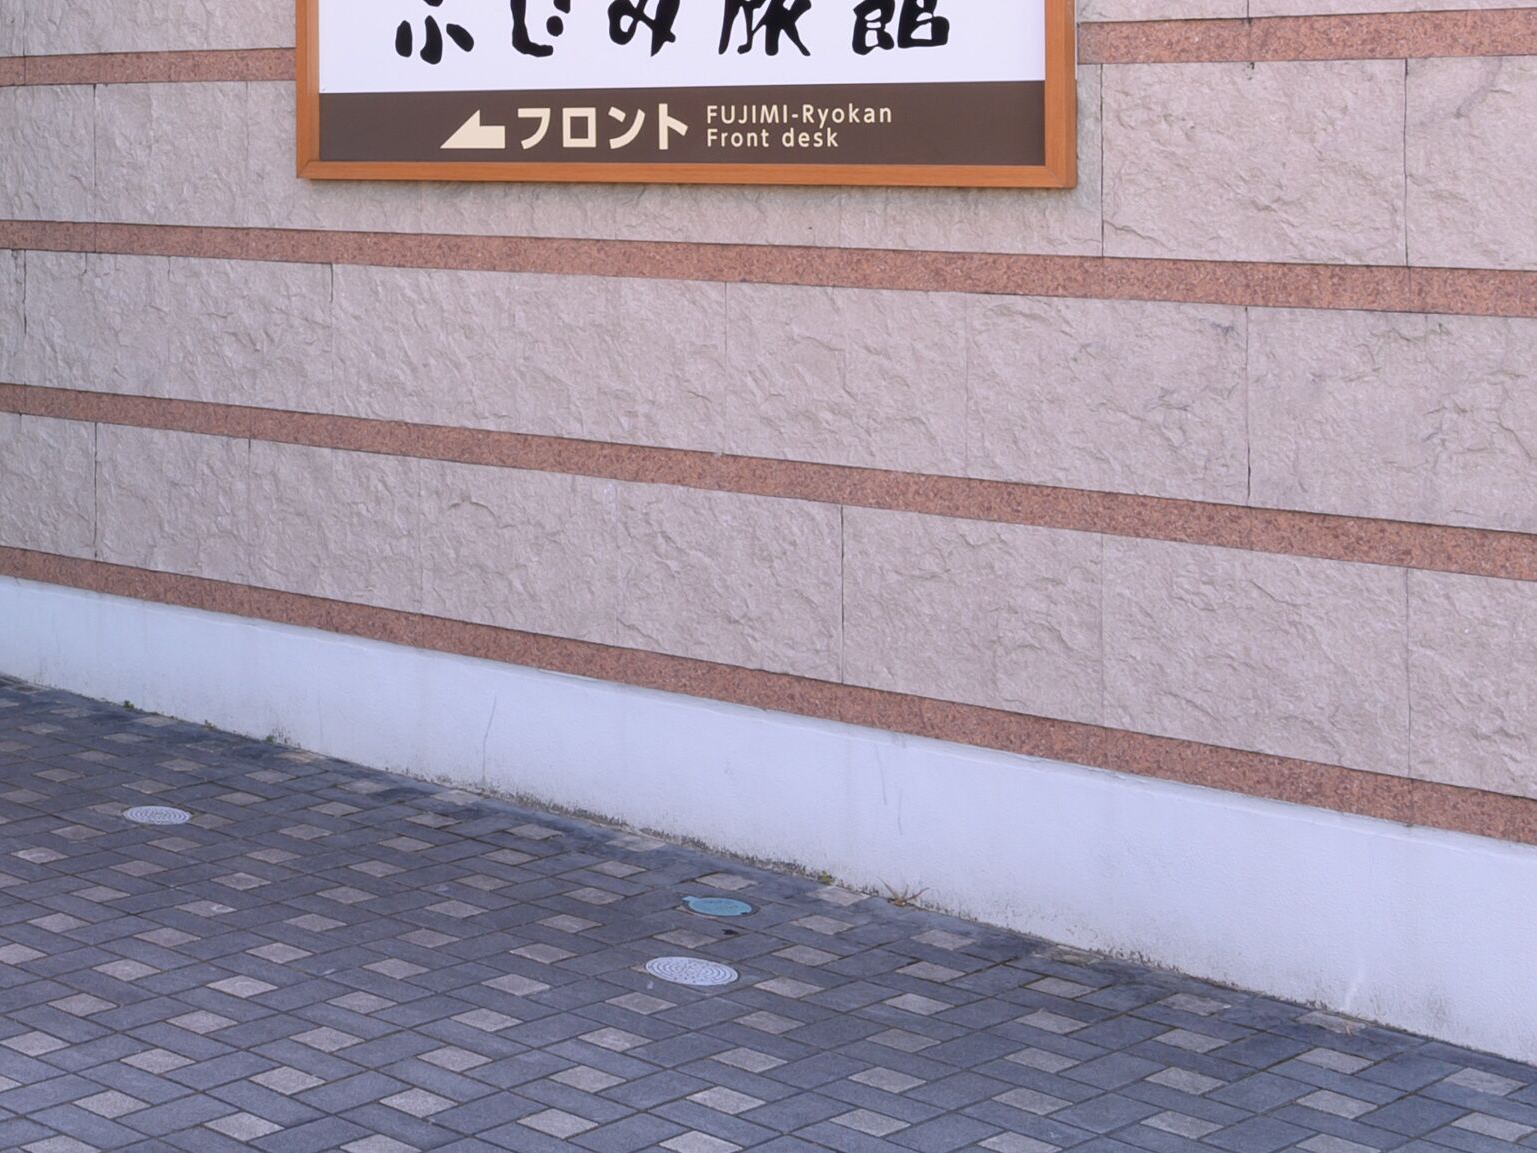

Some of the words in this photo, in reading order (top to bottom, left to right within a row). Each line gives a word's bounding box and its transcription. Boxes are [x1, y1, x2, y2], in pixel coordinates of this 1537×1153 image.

[706, 103, 893, 125] FUJIMI-Ryokan
[517, 103, 689, 150] フロント
[706, 128, 769, 148] Front
[781, 127, 839, 148] desk
